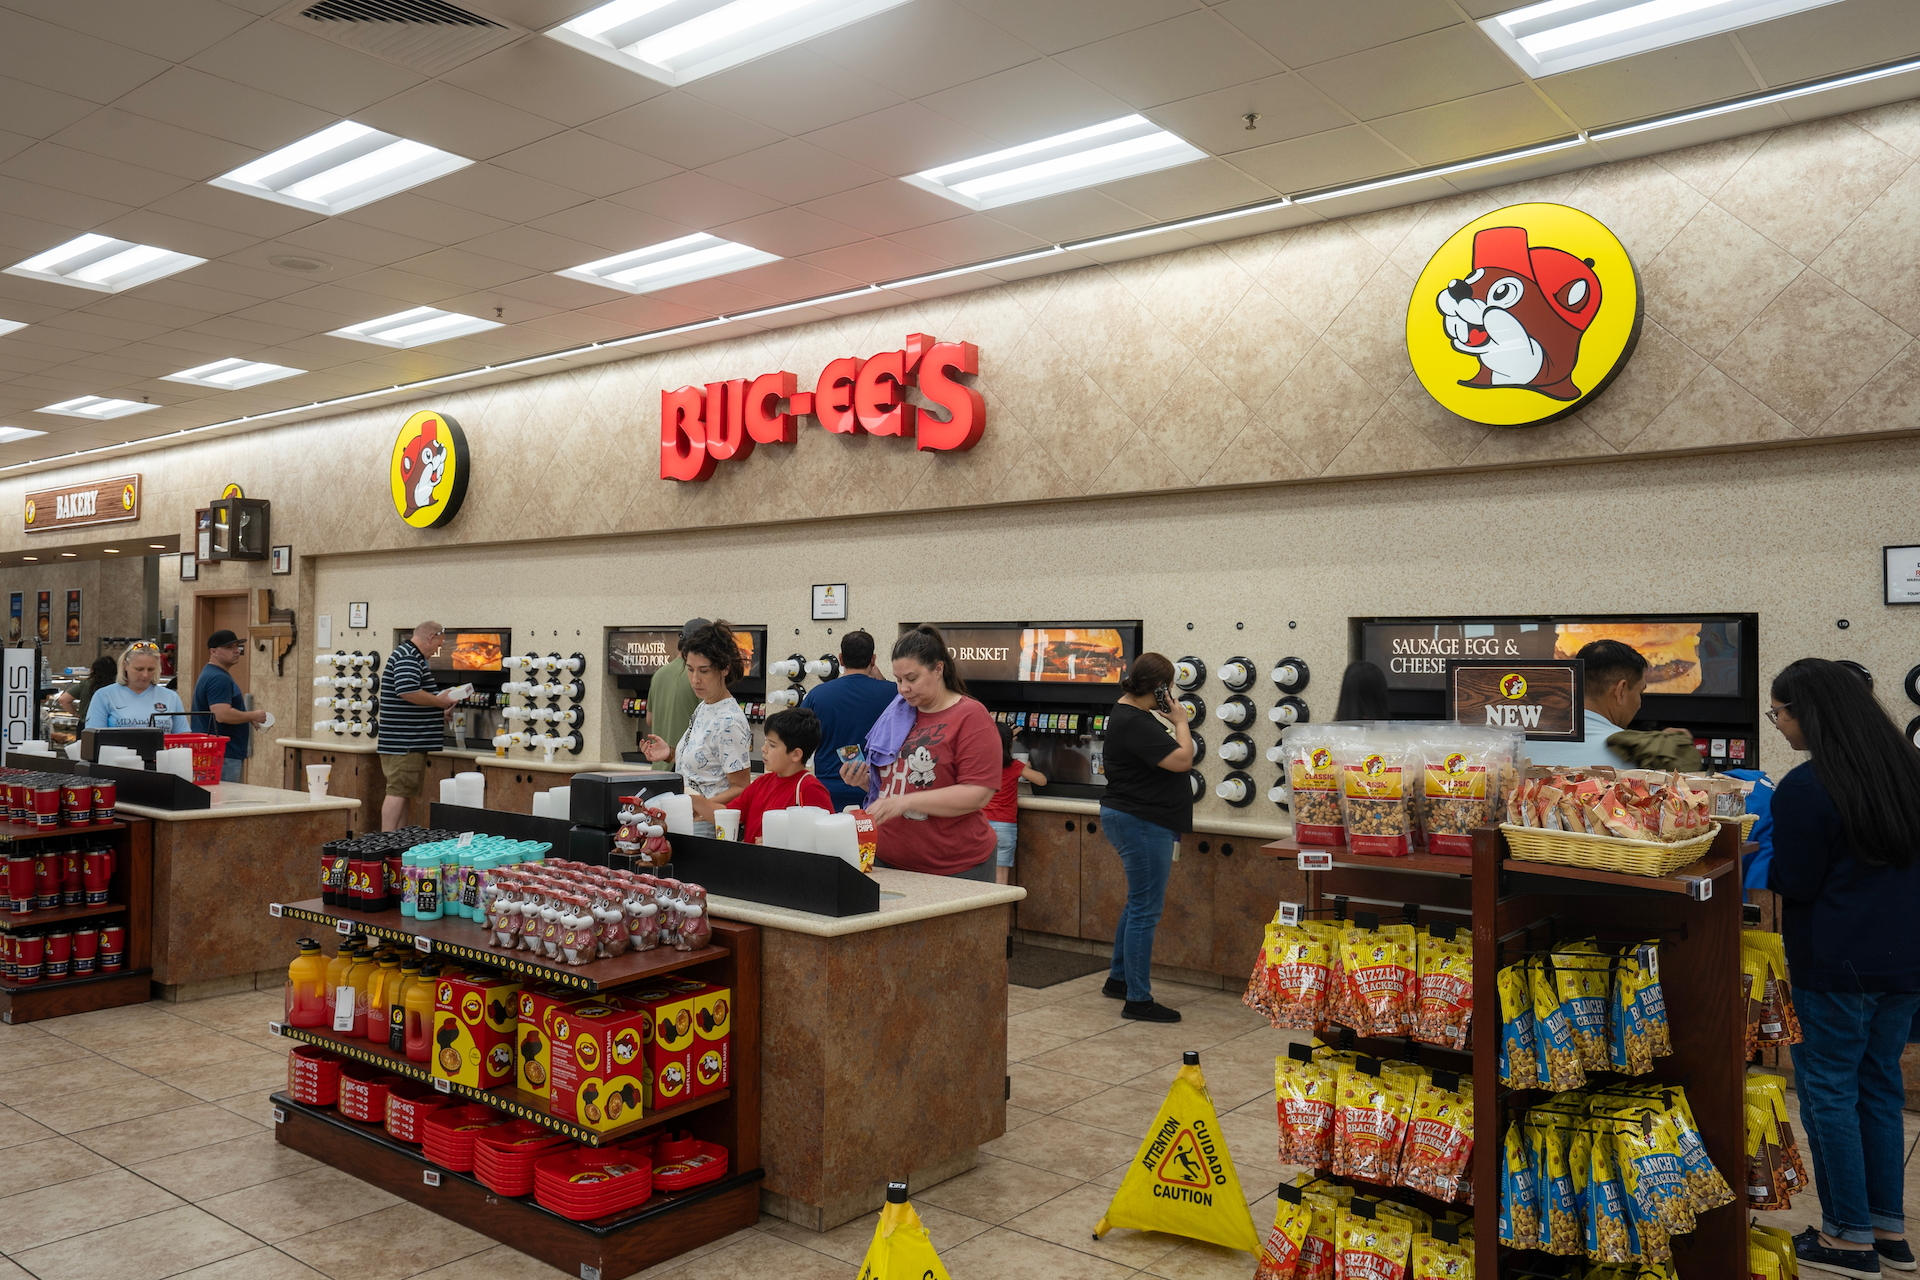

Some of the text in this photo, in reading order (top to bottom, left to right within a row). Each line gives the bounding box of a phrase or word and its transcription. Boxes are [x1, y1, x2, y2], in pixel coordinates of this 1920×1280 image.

[661, 333, 986, 482] BUC-EE'S
[56, 490, 98, 519] BAKERY
[627, 642, 666, 654] PITMASTER
[959, 647, 1009, 661] BRISKET
[1392, 638, 1520, 655] SAUSAGE EGG &
[622, 655, 671, 667] PULLED PORK
[1390, 657, 1446, 674] CHEESE
[1485, 704, 1543, 728] NEW
[857, 824, 874, 832] CHIPS
[1354, 967, 1405, 985] SIZZL'N
[1359, 980, 1404, 994] CRACKERS
[1422, 988, 1458, 1006] RACKERS
[1415, 1121, 1462, 1147] SIZZL'N
[1142, 1116, 1181, 1172] ATTENTION
[1193, 1120, 1226, 1185] CUIDADO
[1153, 1184, 1212, 1207] CAUTION
[1344, 1252, 1393, 1277] SIZZL'N
